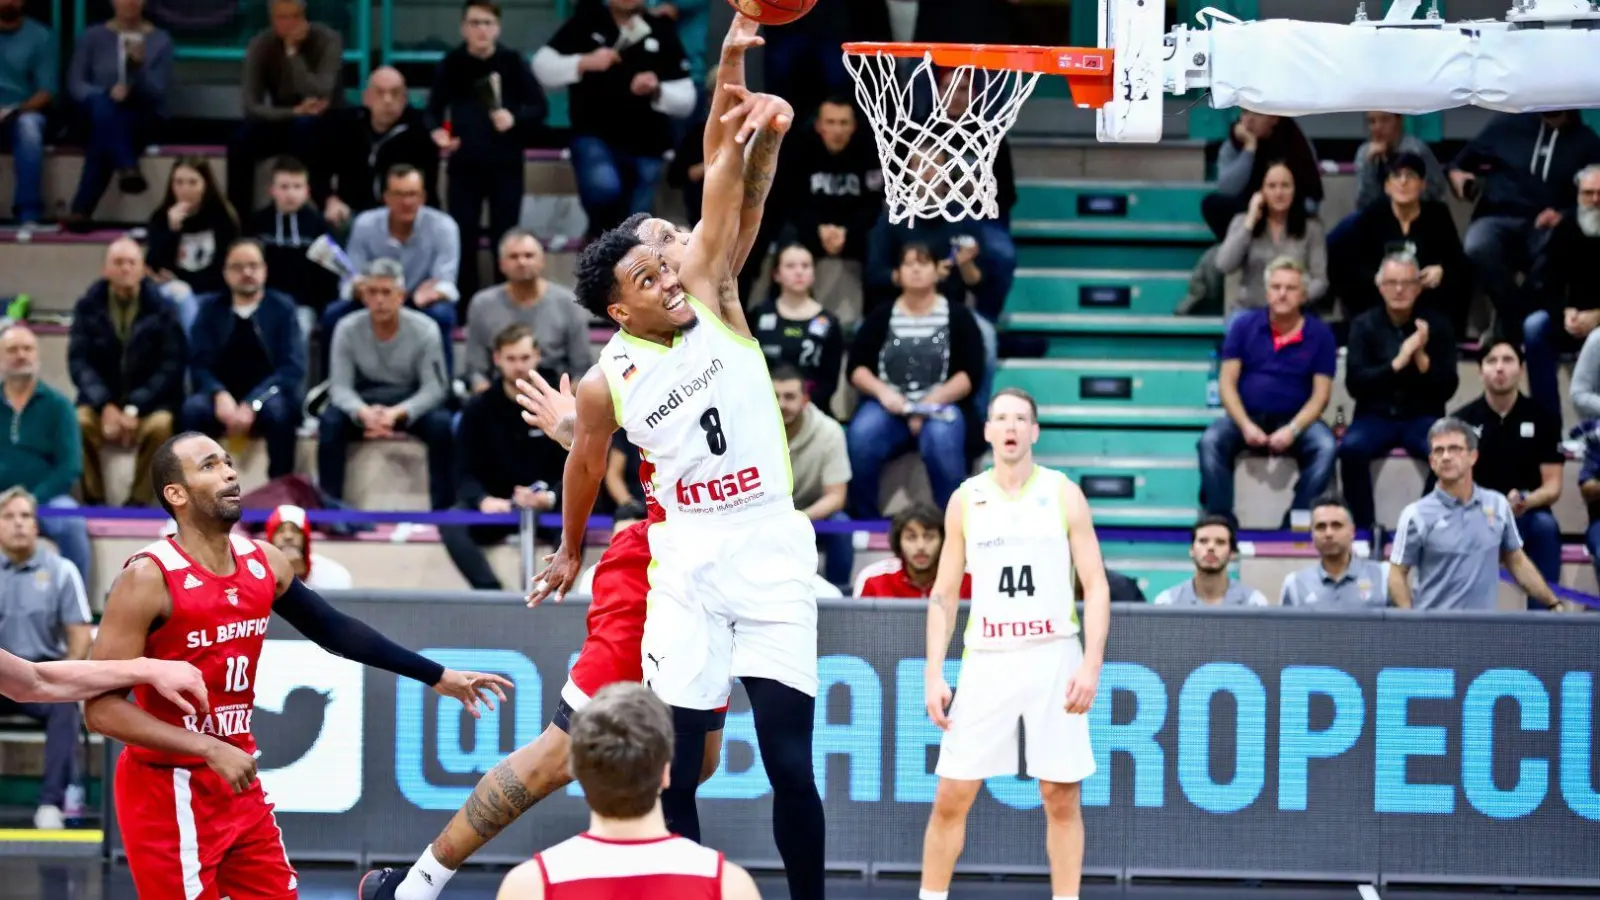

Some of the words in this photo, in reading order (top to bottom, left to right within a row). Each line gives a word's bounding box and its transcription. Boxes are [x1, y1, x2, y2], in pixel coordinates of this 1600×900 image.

[645, 389, 684, 429] medi
[699, 407, 727, 456] 8
[998, 565, 1035, 598] 44
[186, 629, 213, 649] SL
[224, 655, 249, 692] 10
